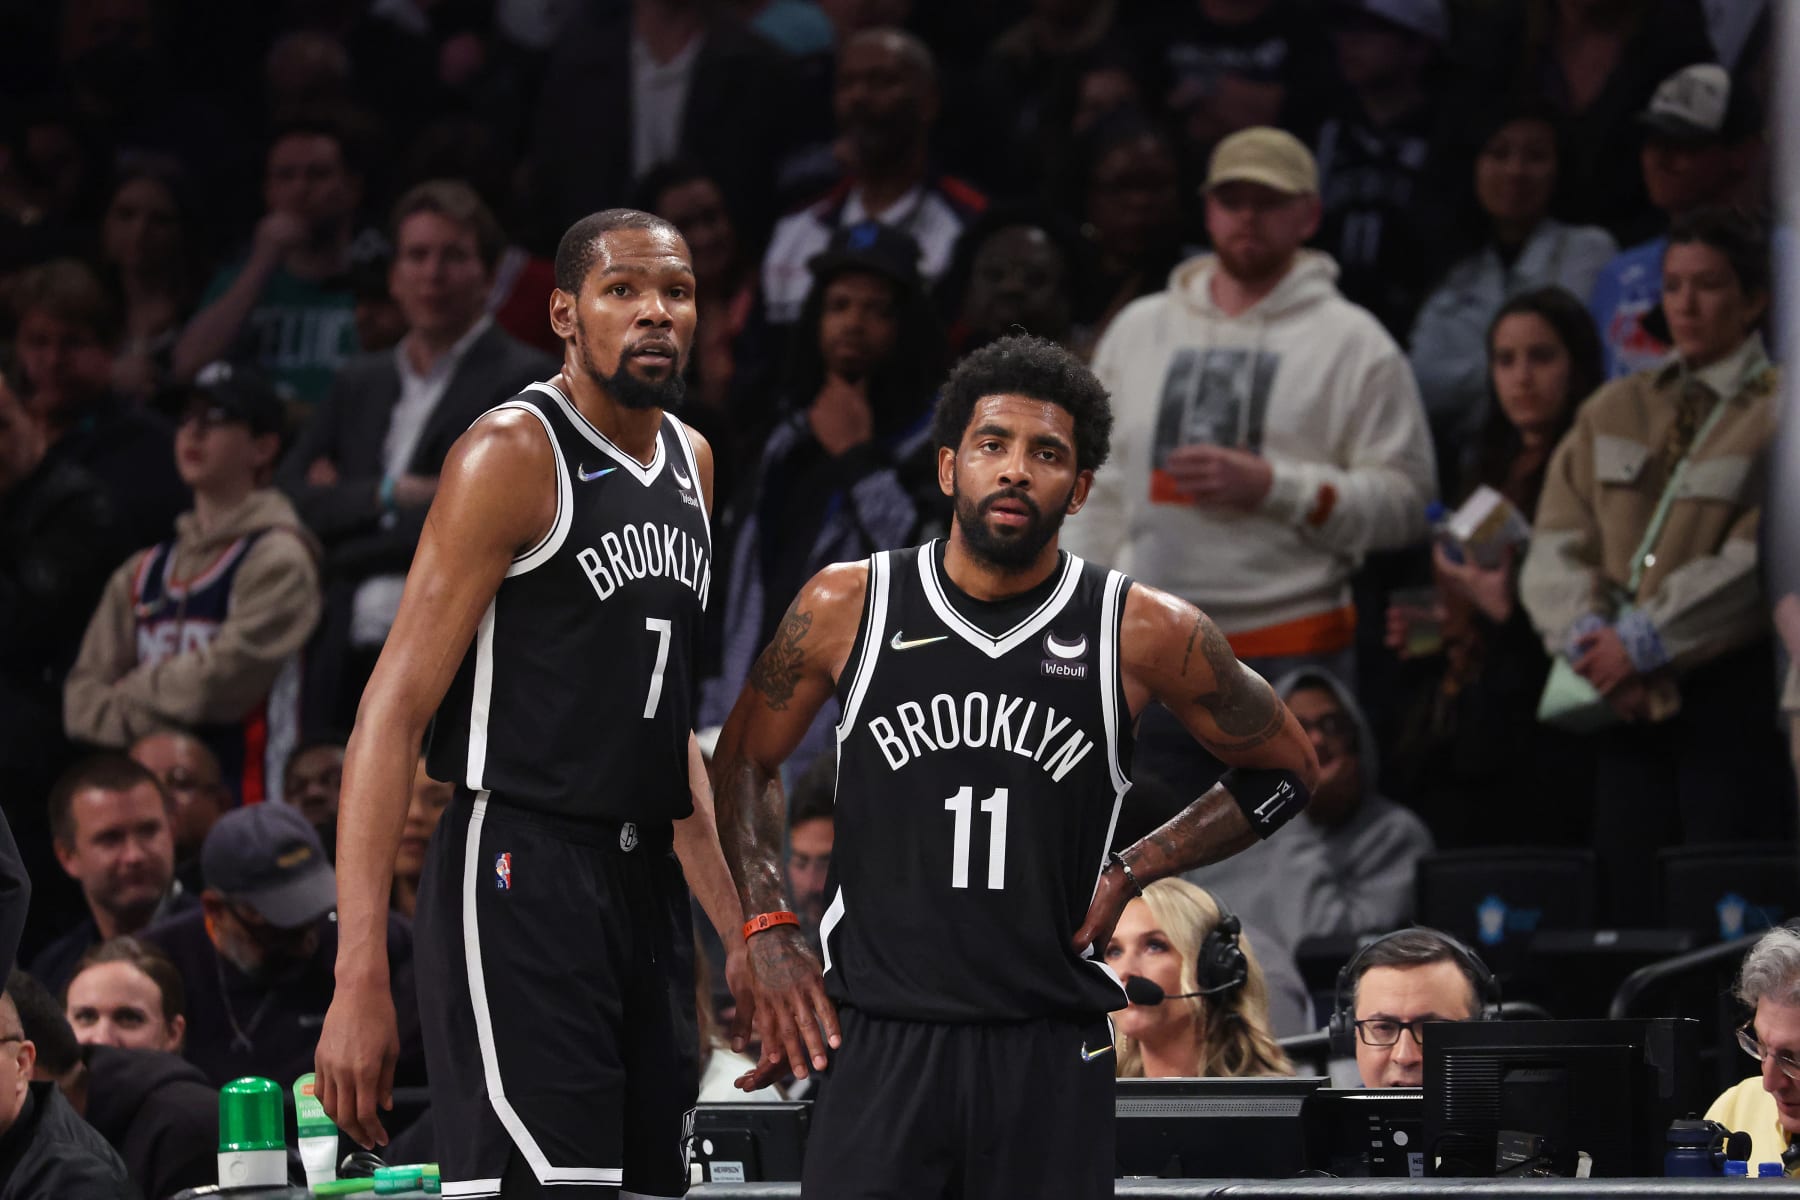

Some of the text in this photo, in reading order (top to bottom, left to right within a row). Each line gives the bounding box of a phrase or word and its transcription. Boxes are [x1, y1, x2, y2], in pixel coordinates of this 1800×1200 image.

[576, 521, 712, 613] BROOKLYN
[643, 617, 672, 719] 7
[1045, 663, 1085, 678] Webull
[868, 691, 1094, 783] BROOKLYN
[944, 786, 1009, 890] 11
